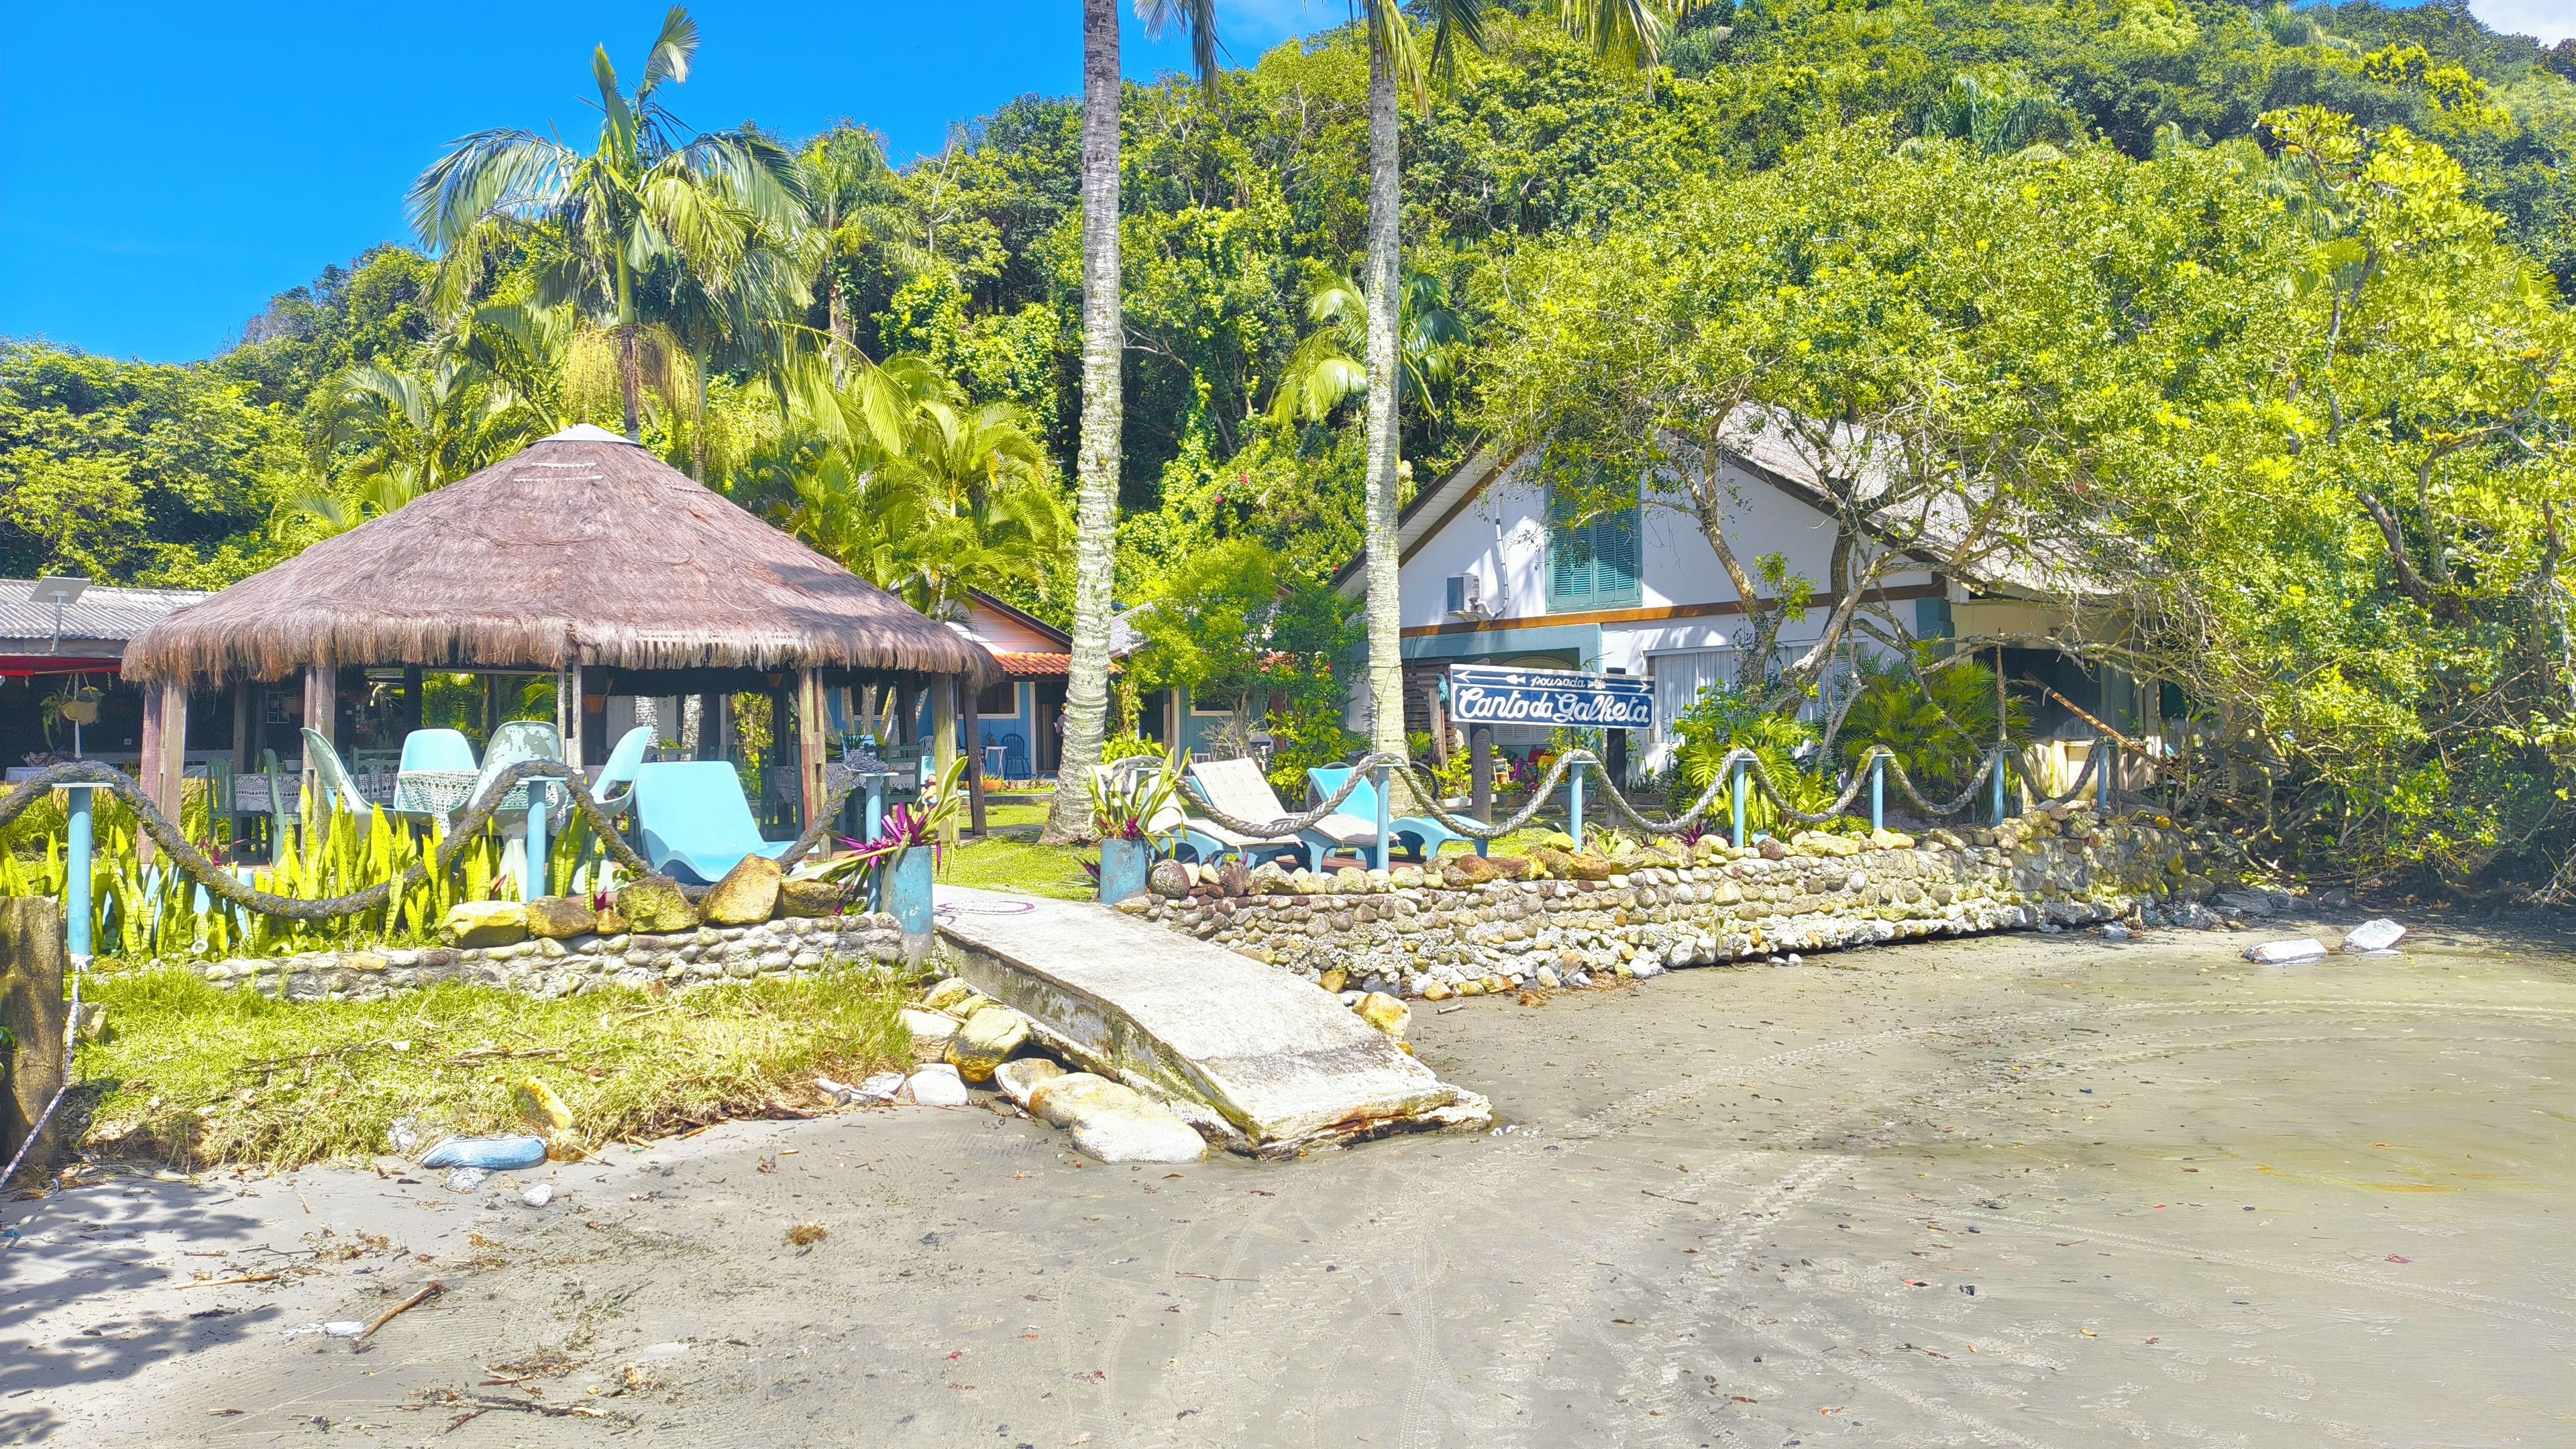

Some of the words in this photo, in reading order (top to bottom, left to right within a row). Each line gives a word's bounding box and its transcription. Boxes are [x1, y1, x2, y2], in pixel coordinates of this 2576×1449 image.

[1530, 675, 1586, 689] pousada
[1458, 688, 1530, 718] Canto
[1529, 692, 1553, 718] da
[1552, 692, 1650, 723] Galheta
